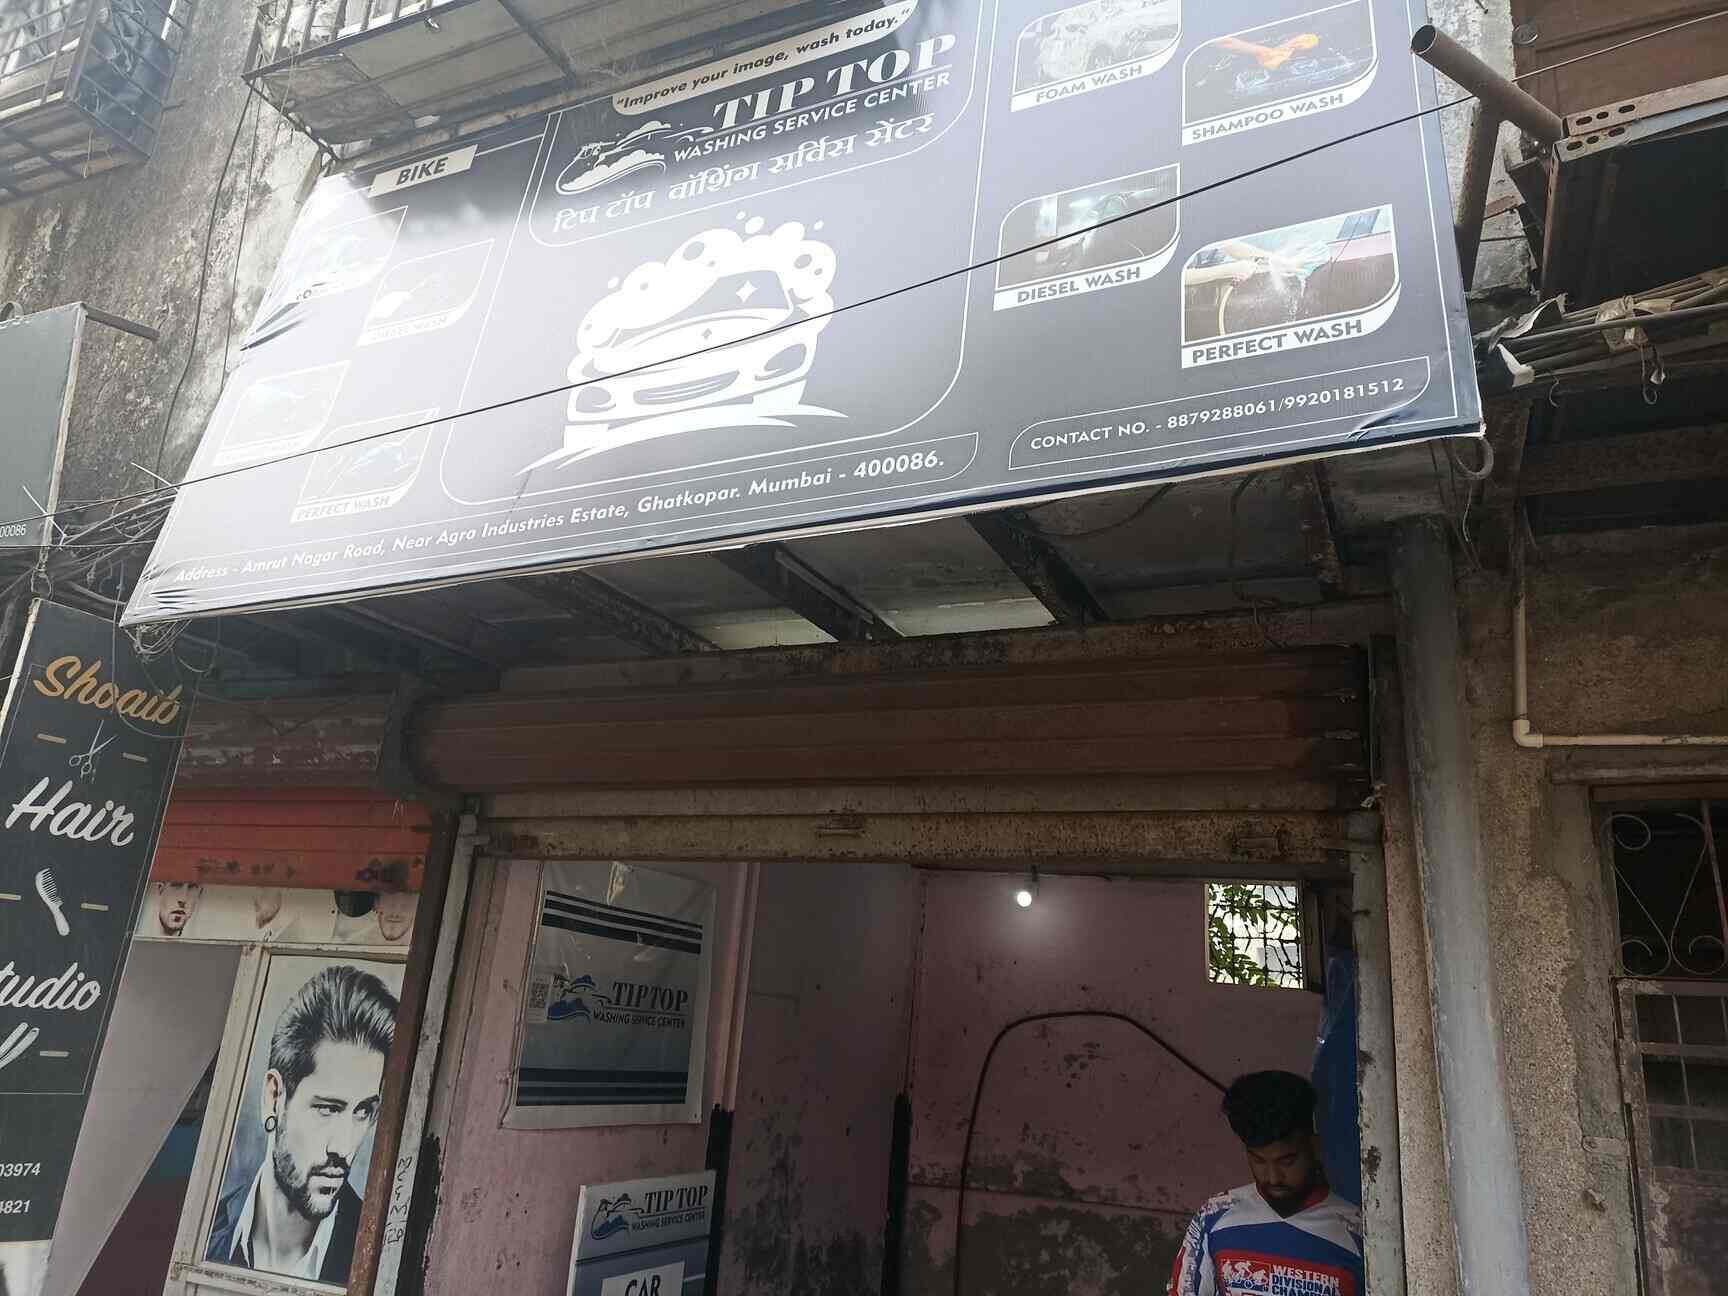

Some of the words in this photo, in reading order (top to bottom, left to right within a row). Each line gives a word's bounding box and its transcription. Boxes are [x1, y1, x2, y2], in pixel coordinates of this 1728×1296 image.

[692, 69, 729, 92] your
[733, 51, 789, 76] image,
[796, 33, 840, 55] wash
[711, 77, 815, 130] TIP
[826, 33, 956, 97] TOP
[1035, 80, 1087, 103] FOAM
[1092, 63, 1143, 87] WASH
[674, 123, 767, 163] WASHING
[772, 99, 857, 135] SERVICE
[864, 71, 951, 108] CENTER
[1192, 108, 1284, 140] SHAMPOO
[1290, 93, 1344, 117] WASH
[397, 158, 448, 185] BIKE
[1016, 282, 1080, 304] DIESEL
[1085, 267, 1141, 289] WASH
[1191, 333, 1288, 364] PERFECT
[1294, 319, 1363, 343] WASH
[1030, 426, 1113, 450] CONTACT
[1117, 420, 1151, 437] NO.
[1167, 377, 1405, 431] 8879288061/9920181512
[174, 565, 229, 583] Address
[242, 556, 288, 573] Amrut
[292, 547, 338, 567] Nagar
[343, 539, 386, 560] Road,
[391, 531, 432, 551] Near
[436, 525, 477, 548] Agro
[480, 514, 564, 538] Industries
[569, 502, 631, 526] Estate,
[637, 484, 741, 515] Ghatkopar.
[748, 466, 833, 496] Mumbai
[852, 449, 945, 479] 400086.
[5, 775, 134, 847] Hair
[612, 980, 649, 1008] TIP
[650, 986, 689, 1012] TOP
[645, 1190, 675, 1213] TIP
[676, 1185, 709, 1208] TOP
[624, 1274, 661, 1296] CAR
[1271, 1274, 1335, 1296] DIVISIONAL
[1272, 1264, 1340, 1288] WESTERN
